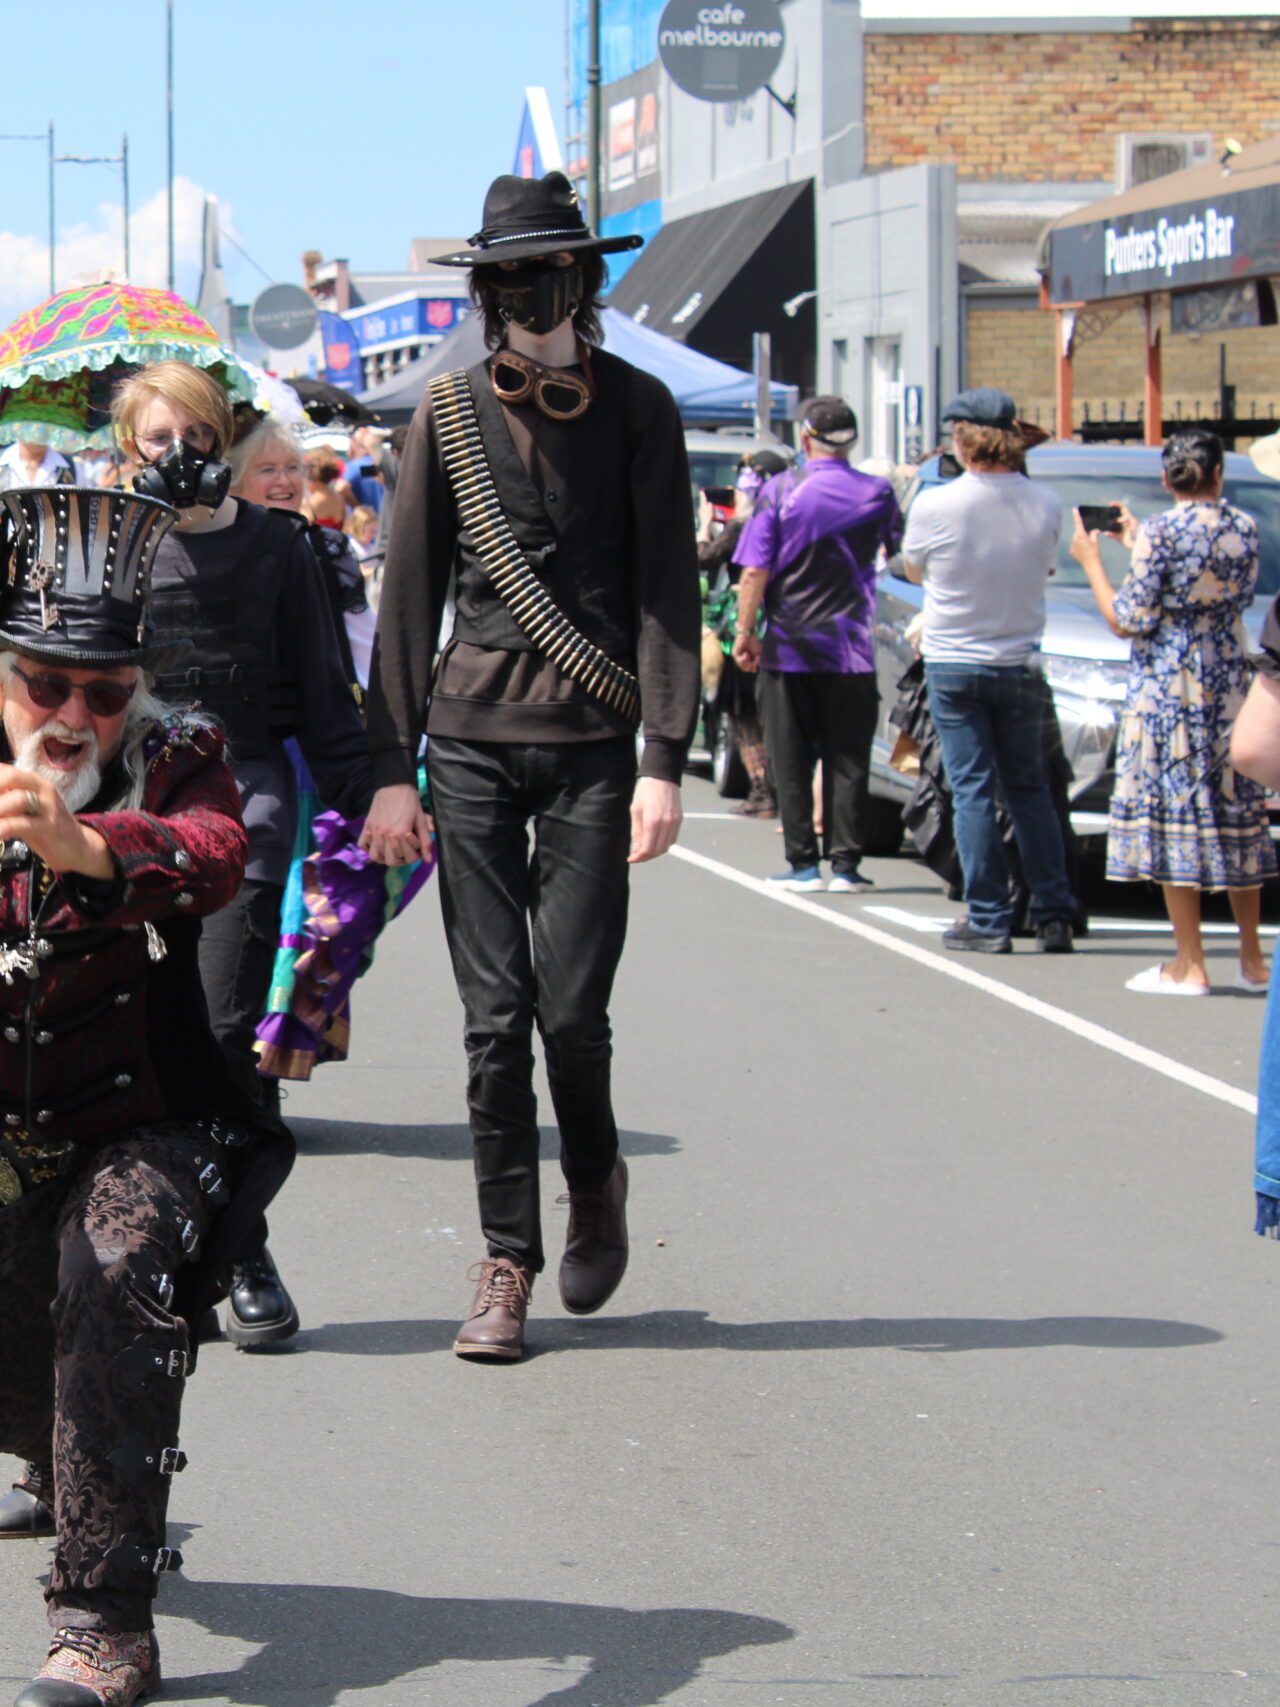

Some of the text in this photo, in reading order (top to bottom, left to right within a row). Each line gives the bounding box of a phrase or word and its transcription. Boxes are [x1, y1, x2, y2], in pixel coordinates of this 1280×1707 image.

[698, 3, 745, 25] cafe
[660, 24, 782, 47] melbourne
[1104, 207, 1234, 277] Punters Sports Bar
